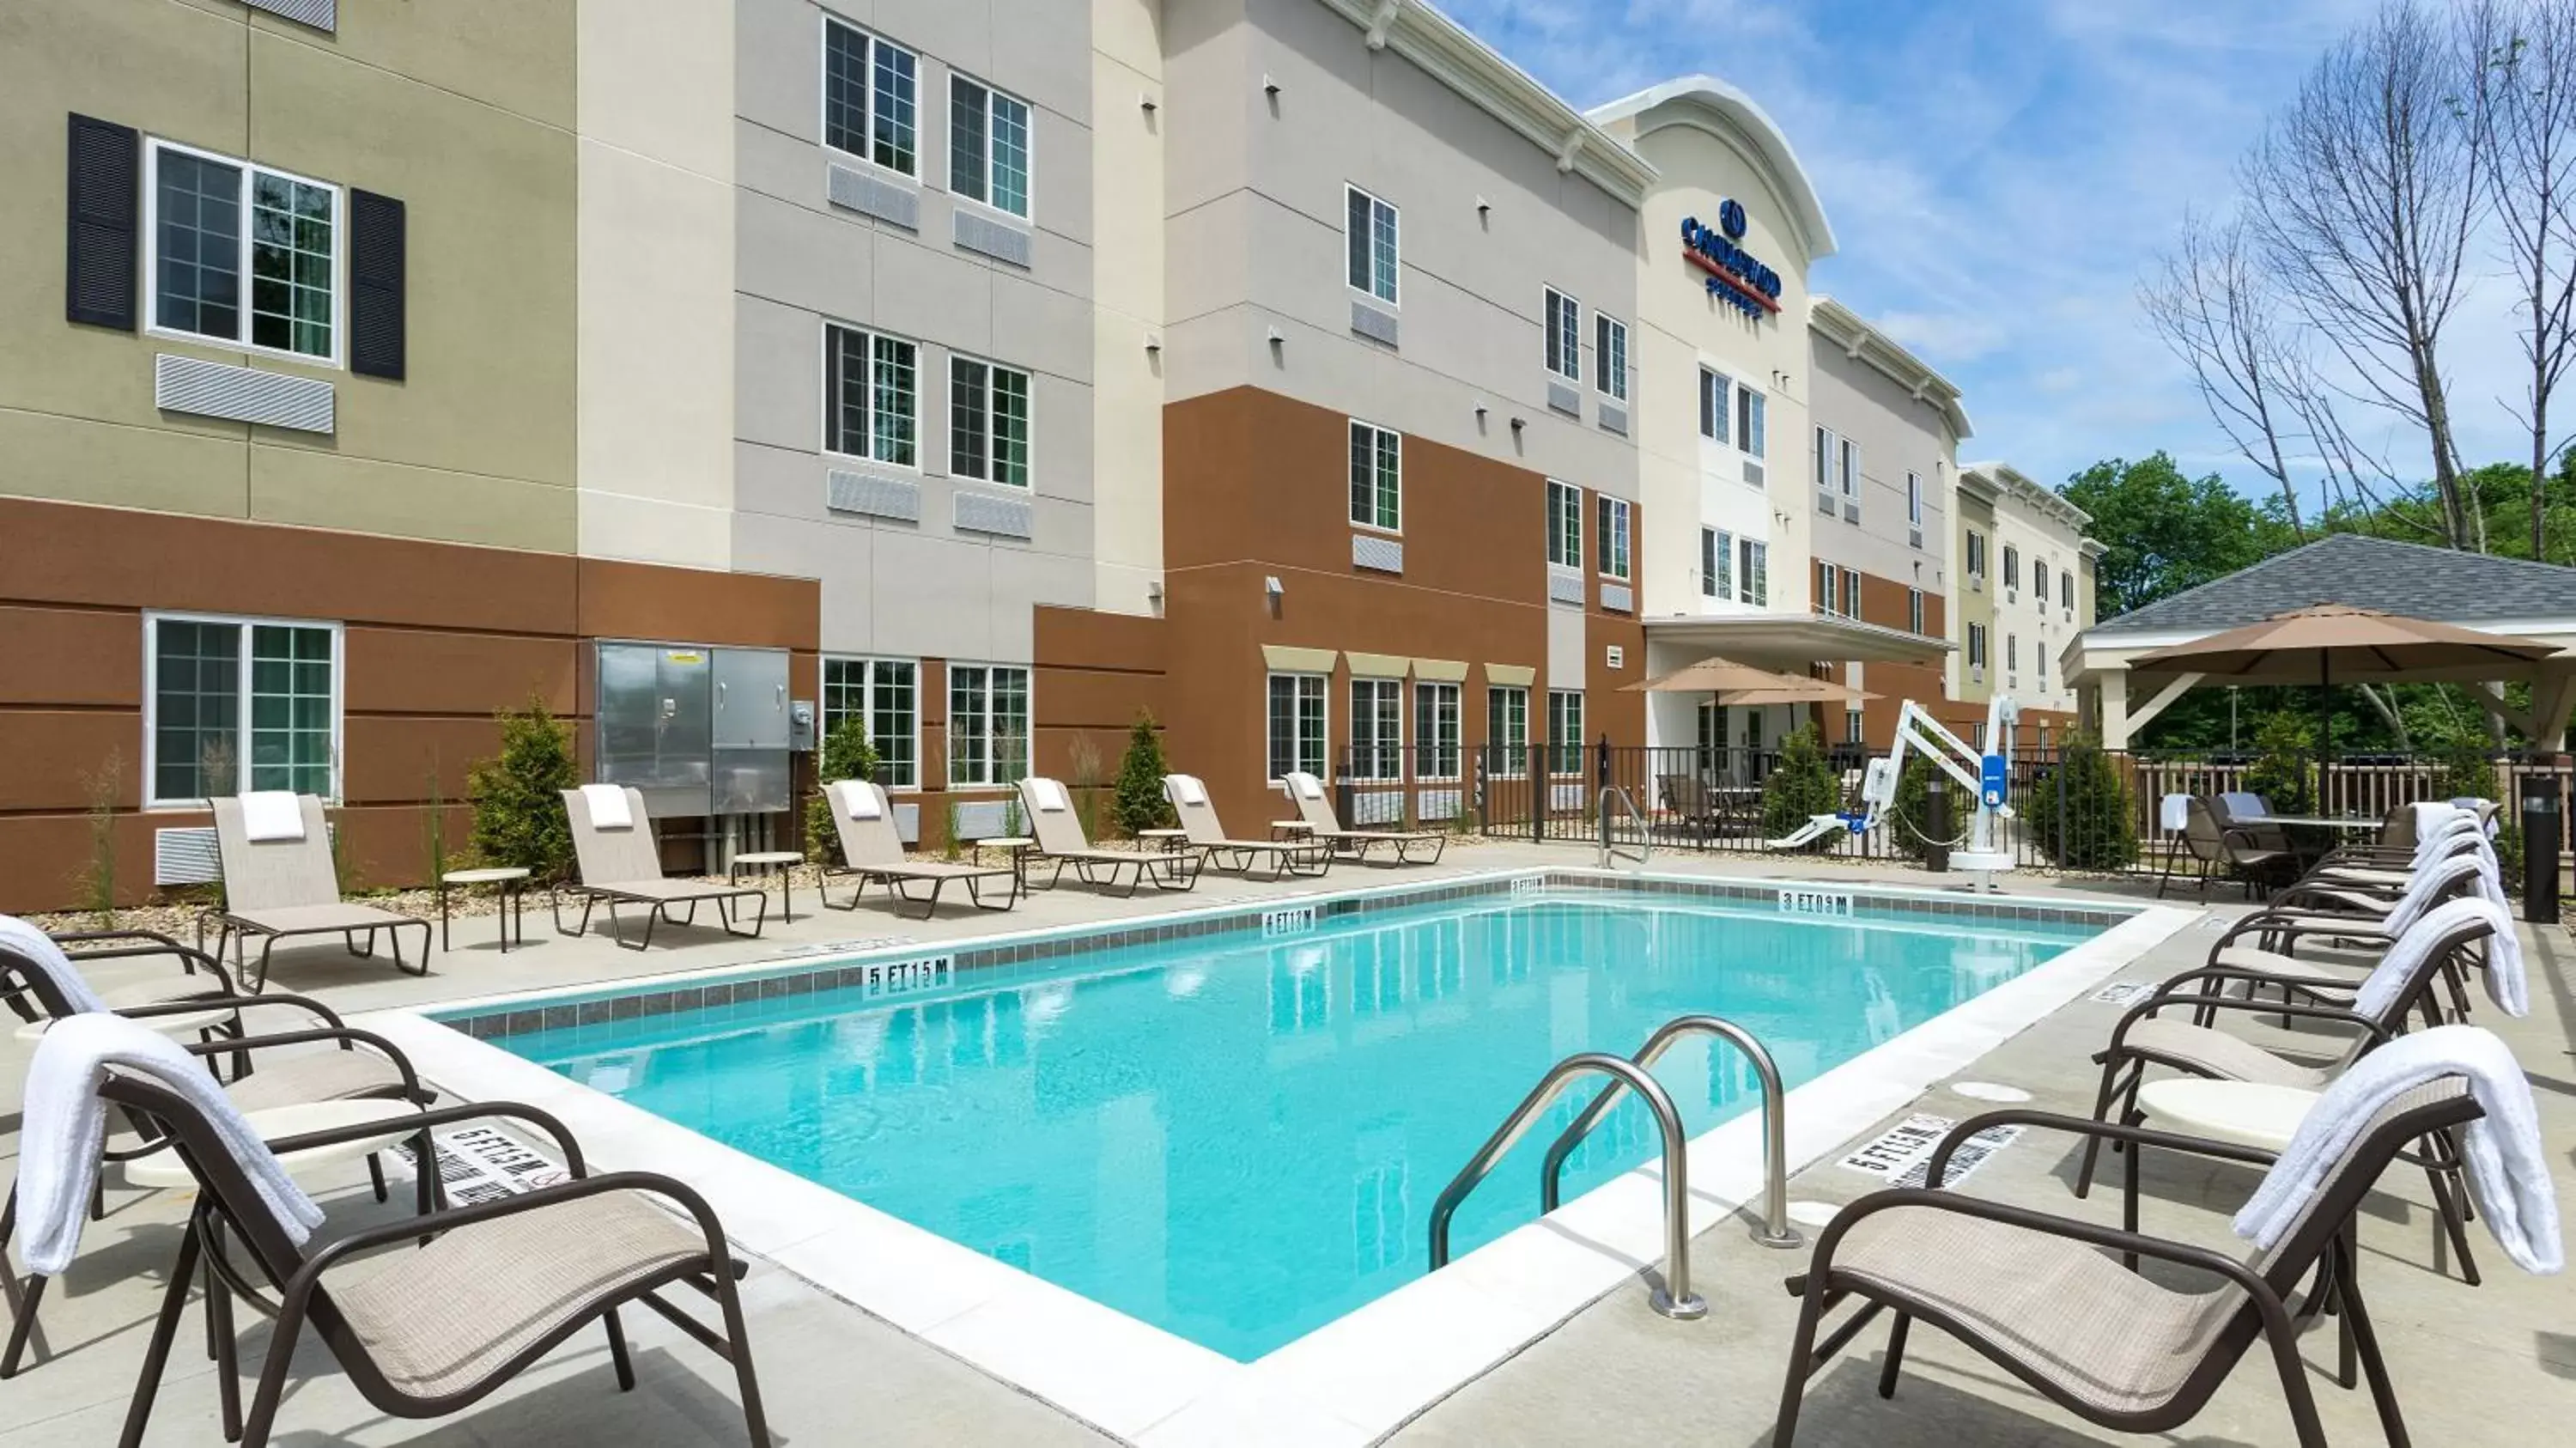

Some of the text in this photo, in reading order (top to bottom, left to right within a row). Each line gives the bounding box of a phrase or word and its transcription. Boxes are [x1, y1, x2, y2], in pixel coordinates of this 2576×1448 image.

[888, 963, 908, 987] FT
[1895, 1125, 1942, 1140] M
[464, 1136, 516, 1153] FT
[501, 1159, 550, 1176] M
[1861, 1144, 1911, 1162] FT
[1847, 1156, 1889, 1171] 5
